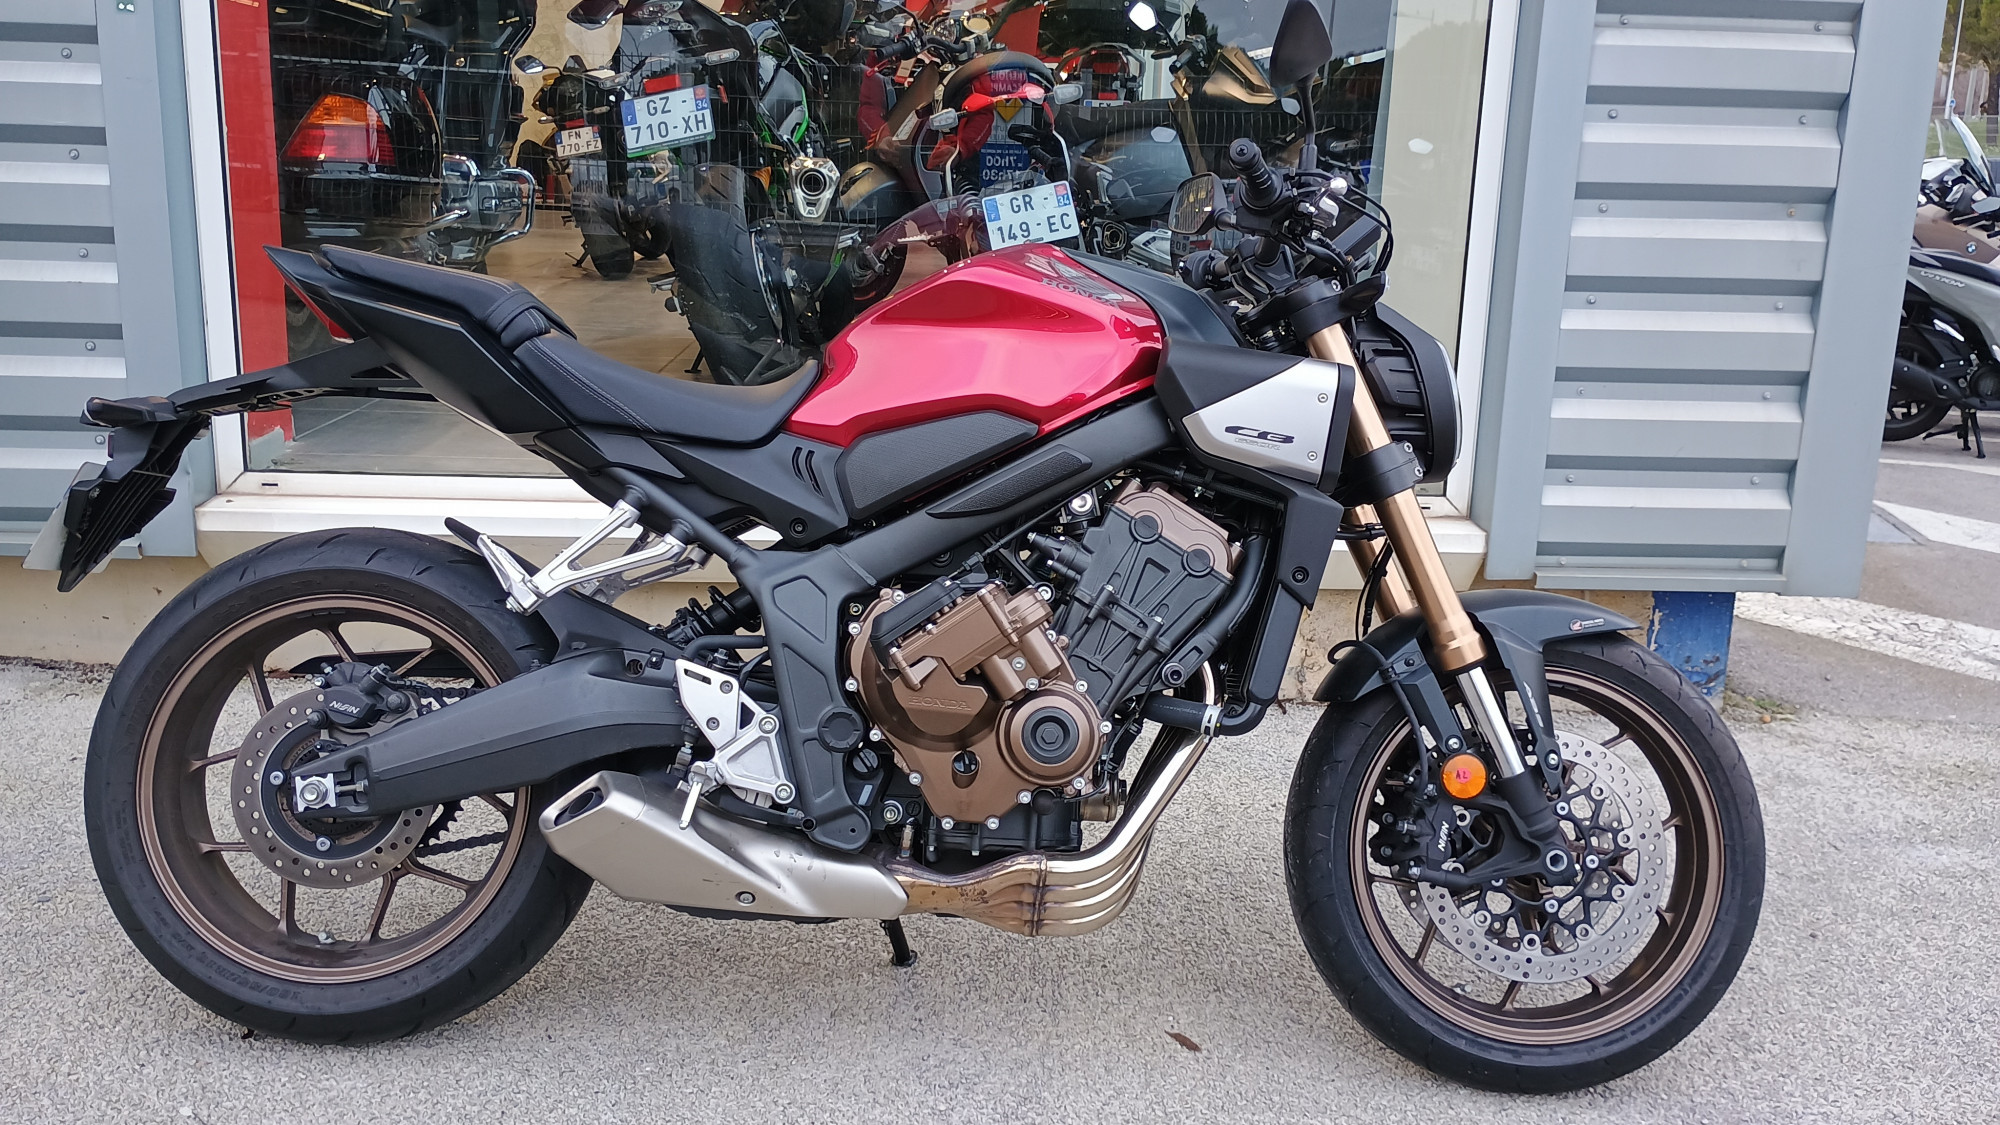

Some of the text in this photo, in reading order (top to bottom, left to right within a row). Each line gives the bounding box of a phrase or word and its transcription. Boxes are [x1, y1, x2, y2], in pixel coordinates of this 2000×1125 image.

[646, 96, 672, 117] GZ
[696, 99, 708, 109] 34
[567, 130, 582, 140] FN
[630, 112, 707, 144] 710-XH
[560, 140, 599, 154] 770-FZ
[1009, 194, 1035, 214] GR
[1057, 195, 1070, 206] 34
[1041, 278, 1120, 309] HONDA
[1224, 425, 1295, 444] CB
[908, 696, 972, 710] HONDA
